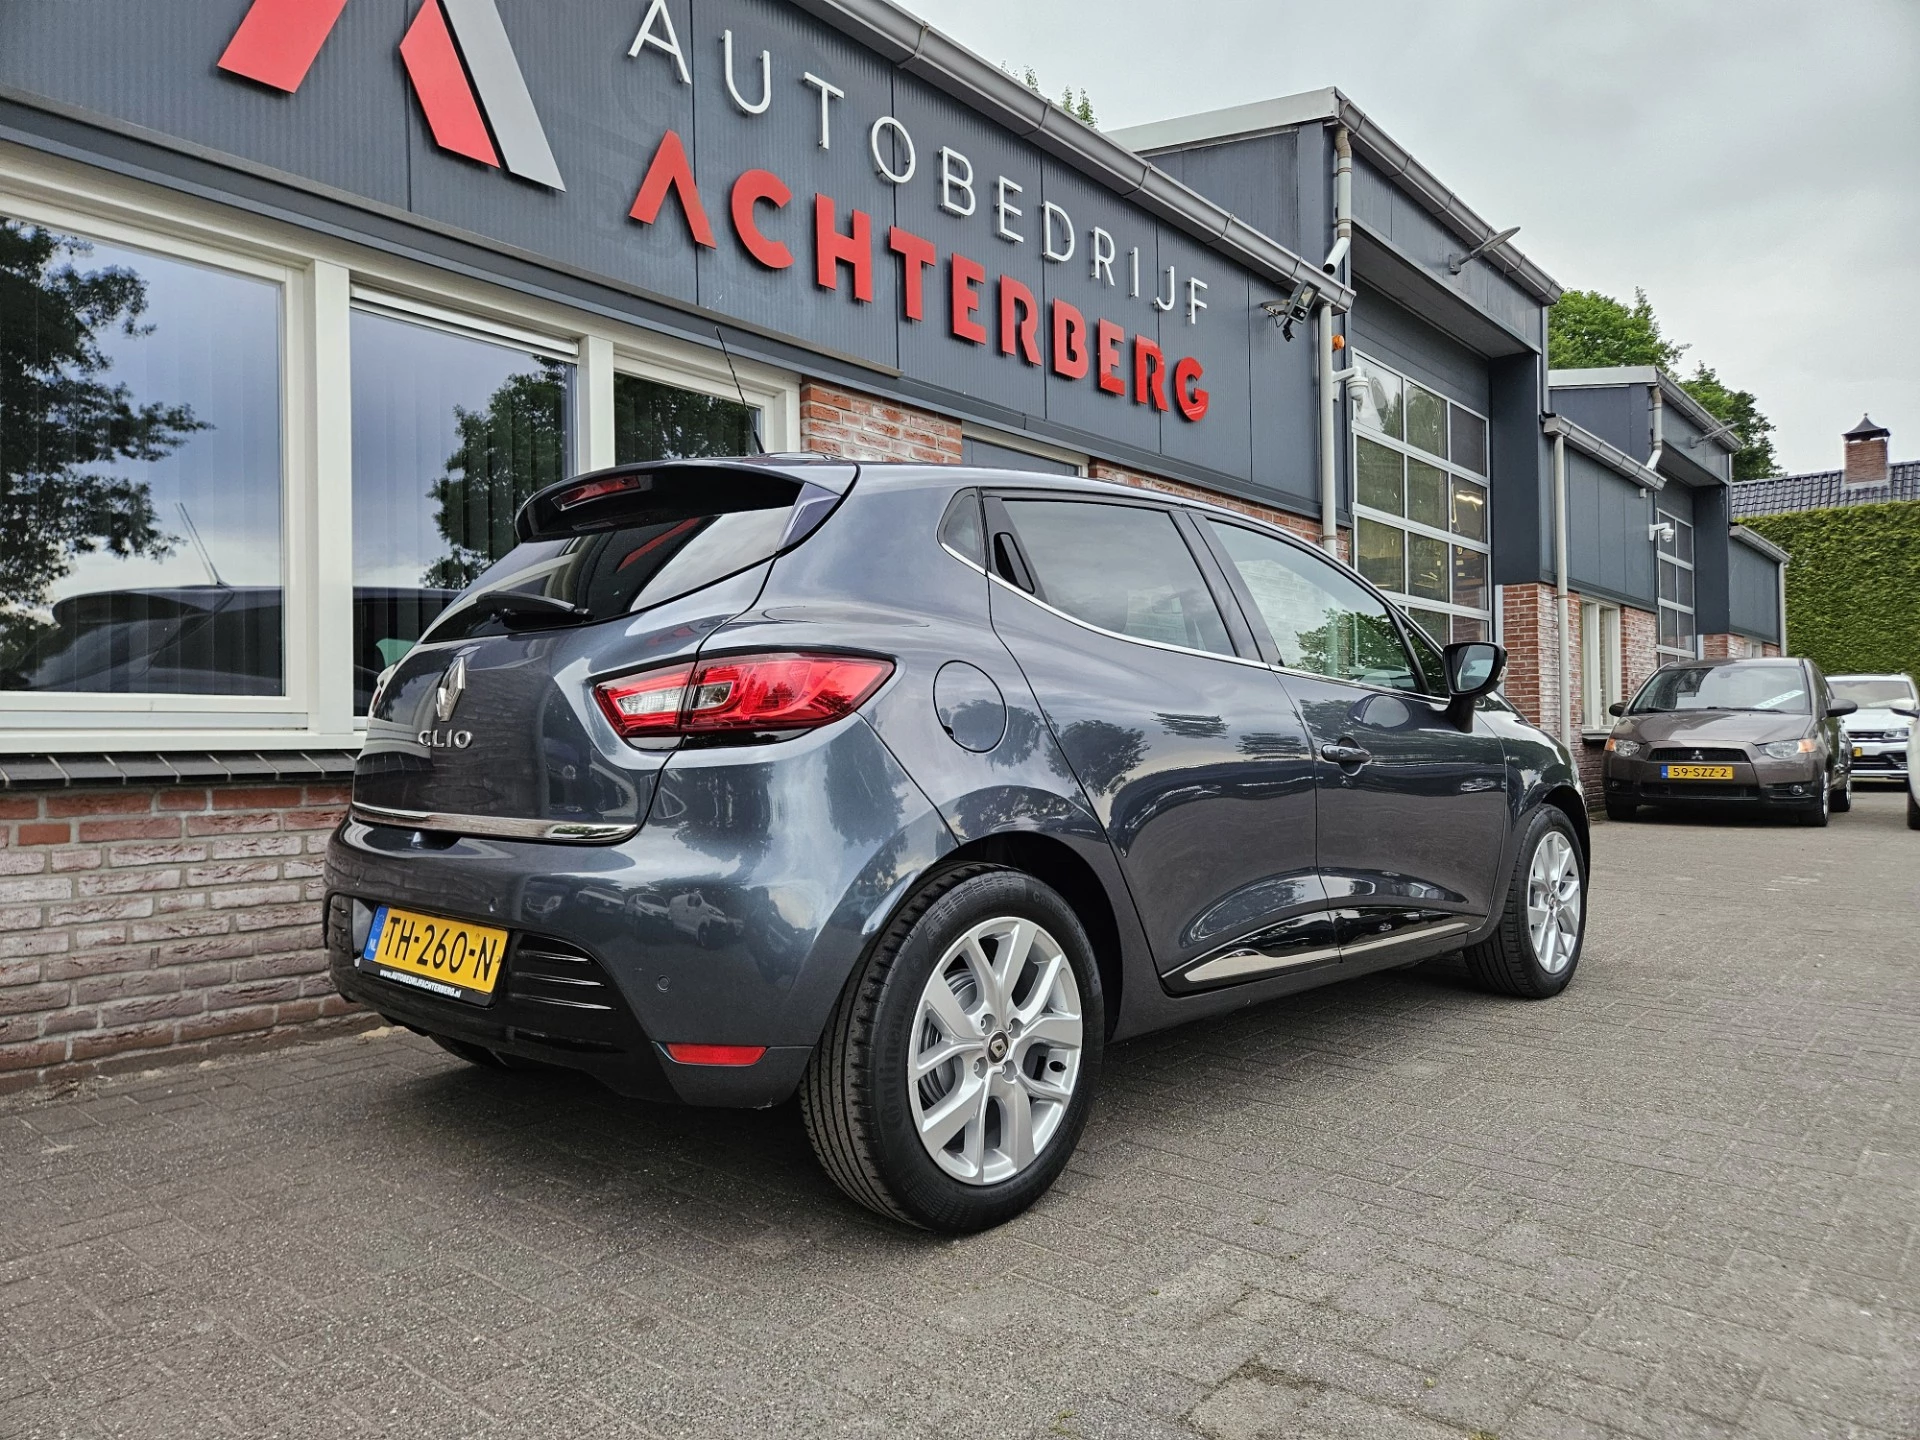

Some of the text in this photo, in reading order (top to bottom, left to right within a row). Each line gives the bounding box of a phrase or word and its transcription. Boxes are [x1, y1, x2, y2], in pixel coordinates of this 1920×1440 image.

[628, 0, 1208, 324] AUTOBEDRIJF
[629, 129, 1210, 422] ACHTERBERG
[418, 729, 473, 749] CLIO
[1673, 767, 1728, 778] 59-SZZ-2
[384, 916, 498, 982] TH-260-N
